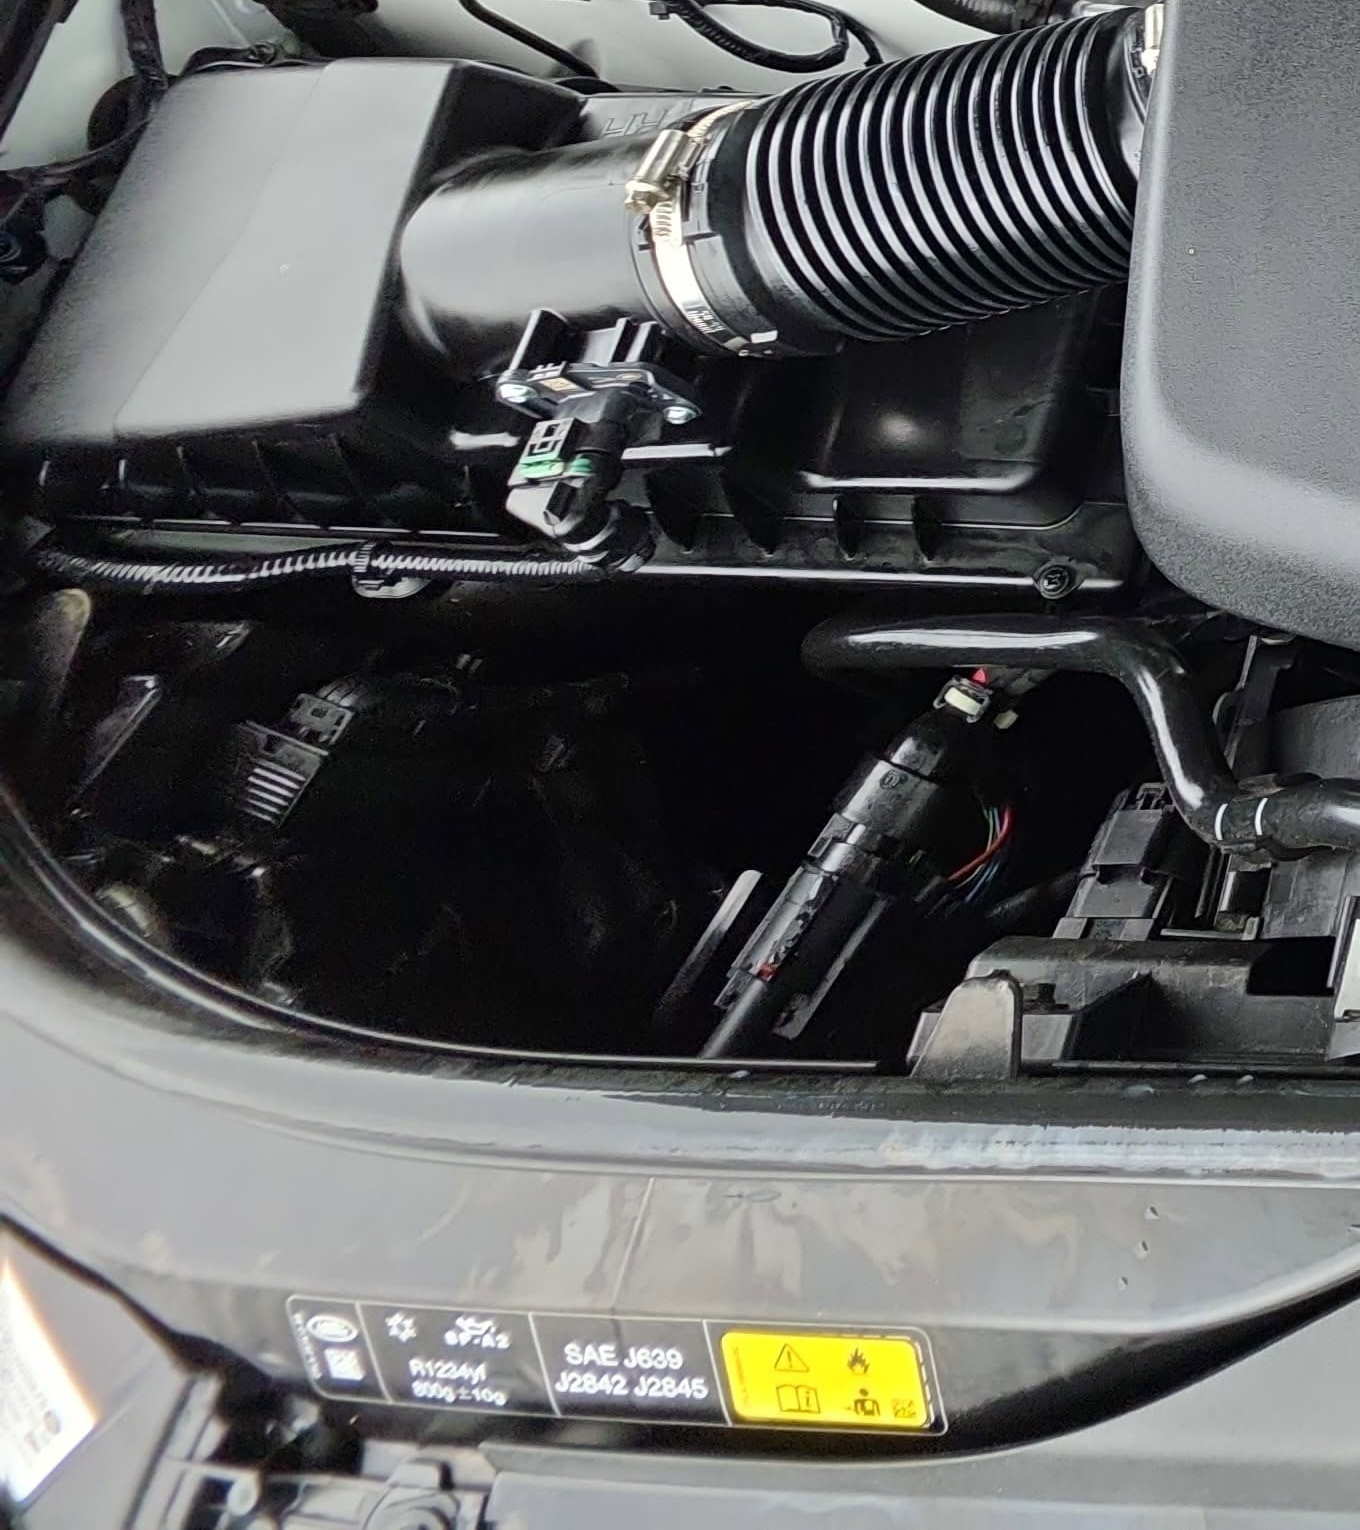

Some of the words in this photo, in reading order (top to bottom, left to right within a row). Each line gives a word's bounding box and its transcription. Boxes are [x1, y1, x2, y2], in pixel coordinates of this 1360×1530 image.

[563, 1341, 619, 1367] SAE
[622, 1346, 685, 1370] J639
[554, 1370, 630, 1397] J2842
[632, 1374, 709, 1400] J2845
